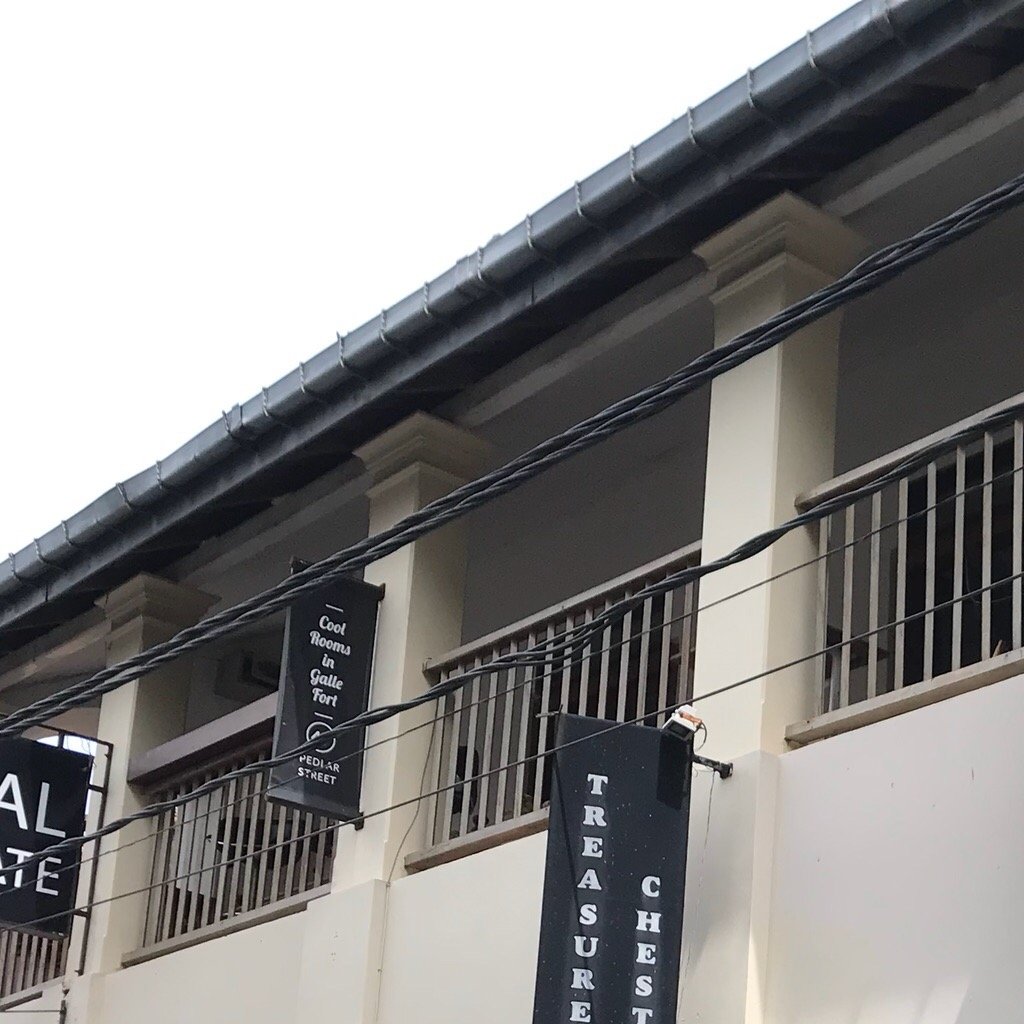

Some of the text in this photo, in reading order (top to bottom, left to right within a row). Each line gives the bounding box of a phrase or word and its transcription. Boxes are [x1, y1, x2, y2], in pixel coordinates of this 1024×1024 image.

[319, 615, 347, 636] Cool
[309, 630, 351, 656] Rooms
[321, 653, 335, 669] in
[310, 668, 344, 691] Galle
[312, 687, 338, 708] Fort
[297, 766, 337, 785] STREET
[569, 773, 609, 1023] TREASURE
